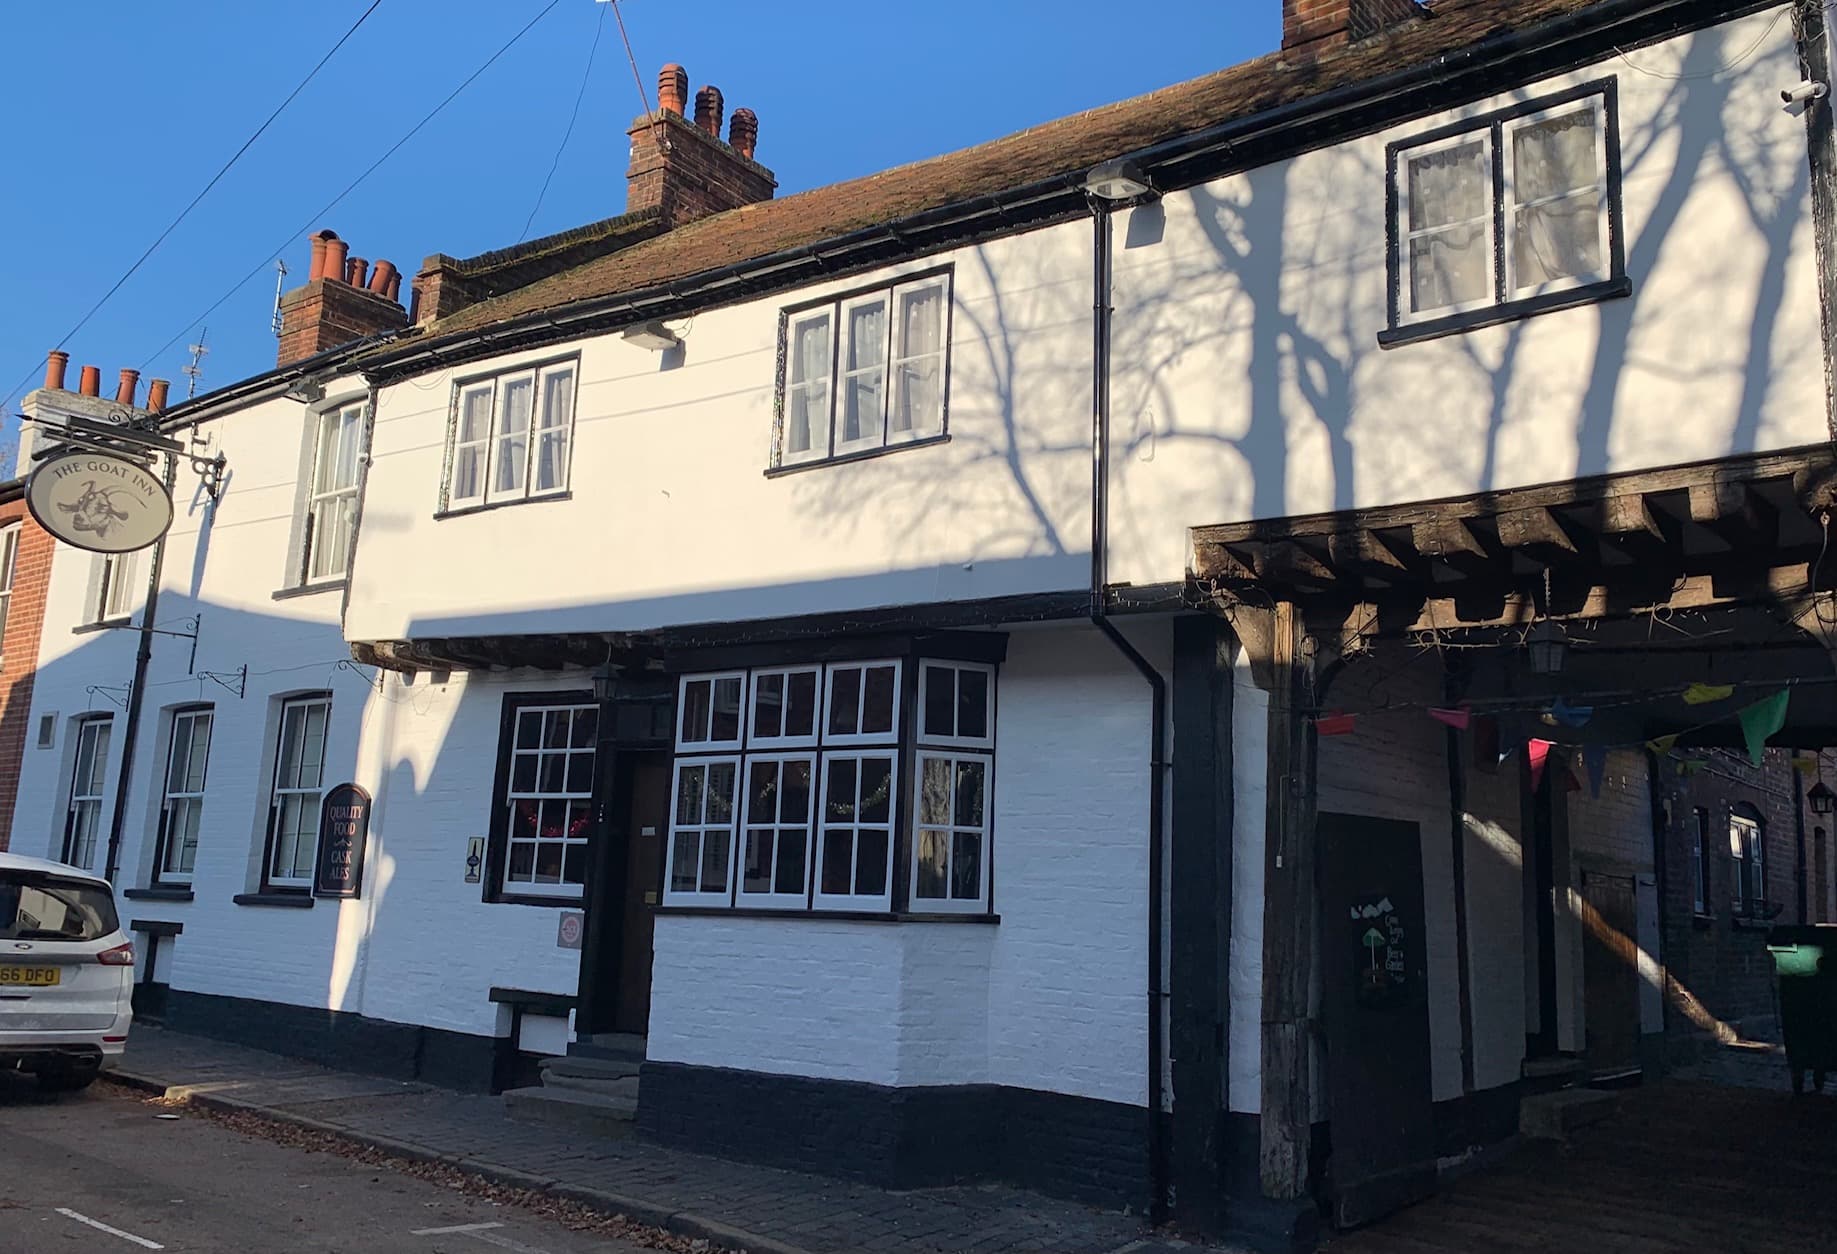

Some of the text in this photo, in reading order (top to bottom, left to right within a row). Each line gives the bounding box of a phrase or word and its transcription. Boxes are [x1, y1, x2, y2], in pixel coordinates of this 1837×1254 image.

[53, 461, 156, 496] THE GOAT INN
[330, 805, 364, 821] QUALITY
[334, 822, 356, 835] FOOD
[331, 850, 352, 865] CASK
[329, 867, 350, 881] ALES
[25, 968, 54, 982] DFO
